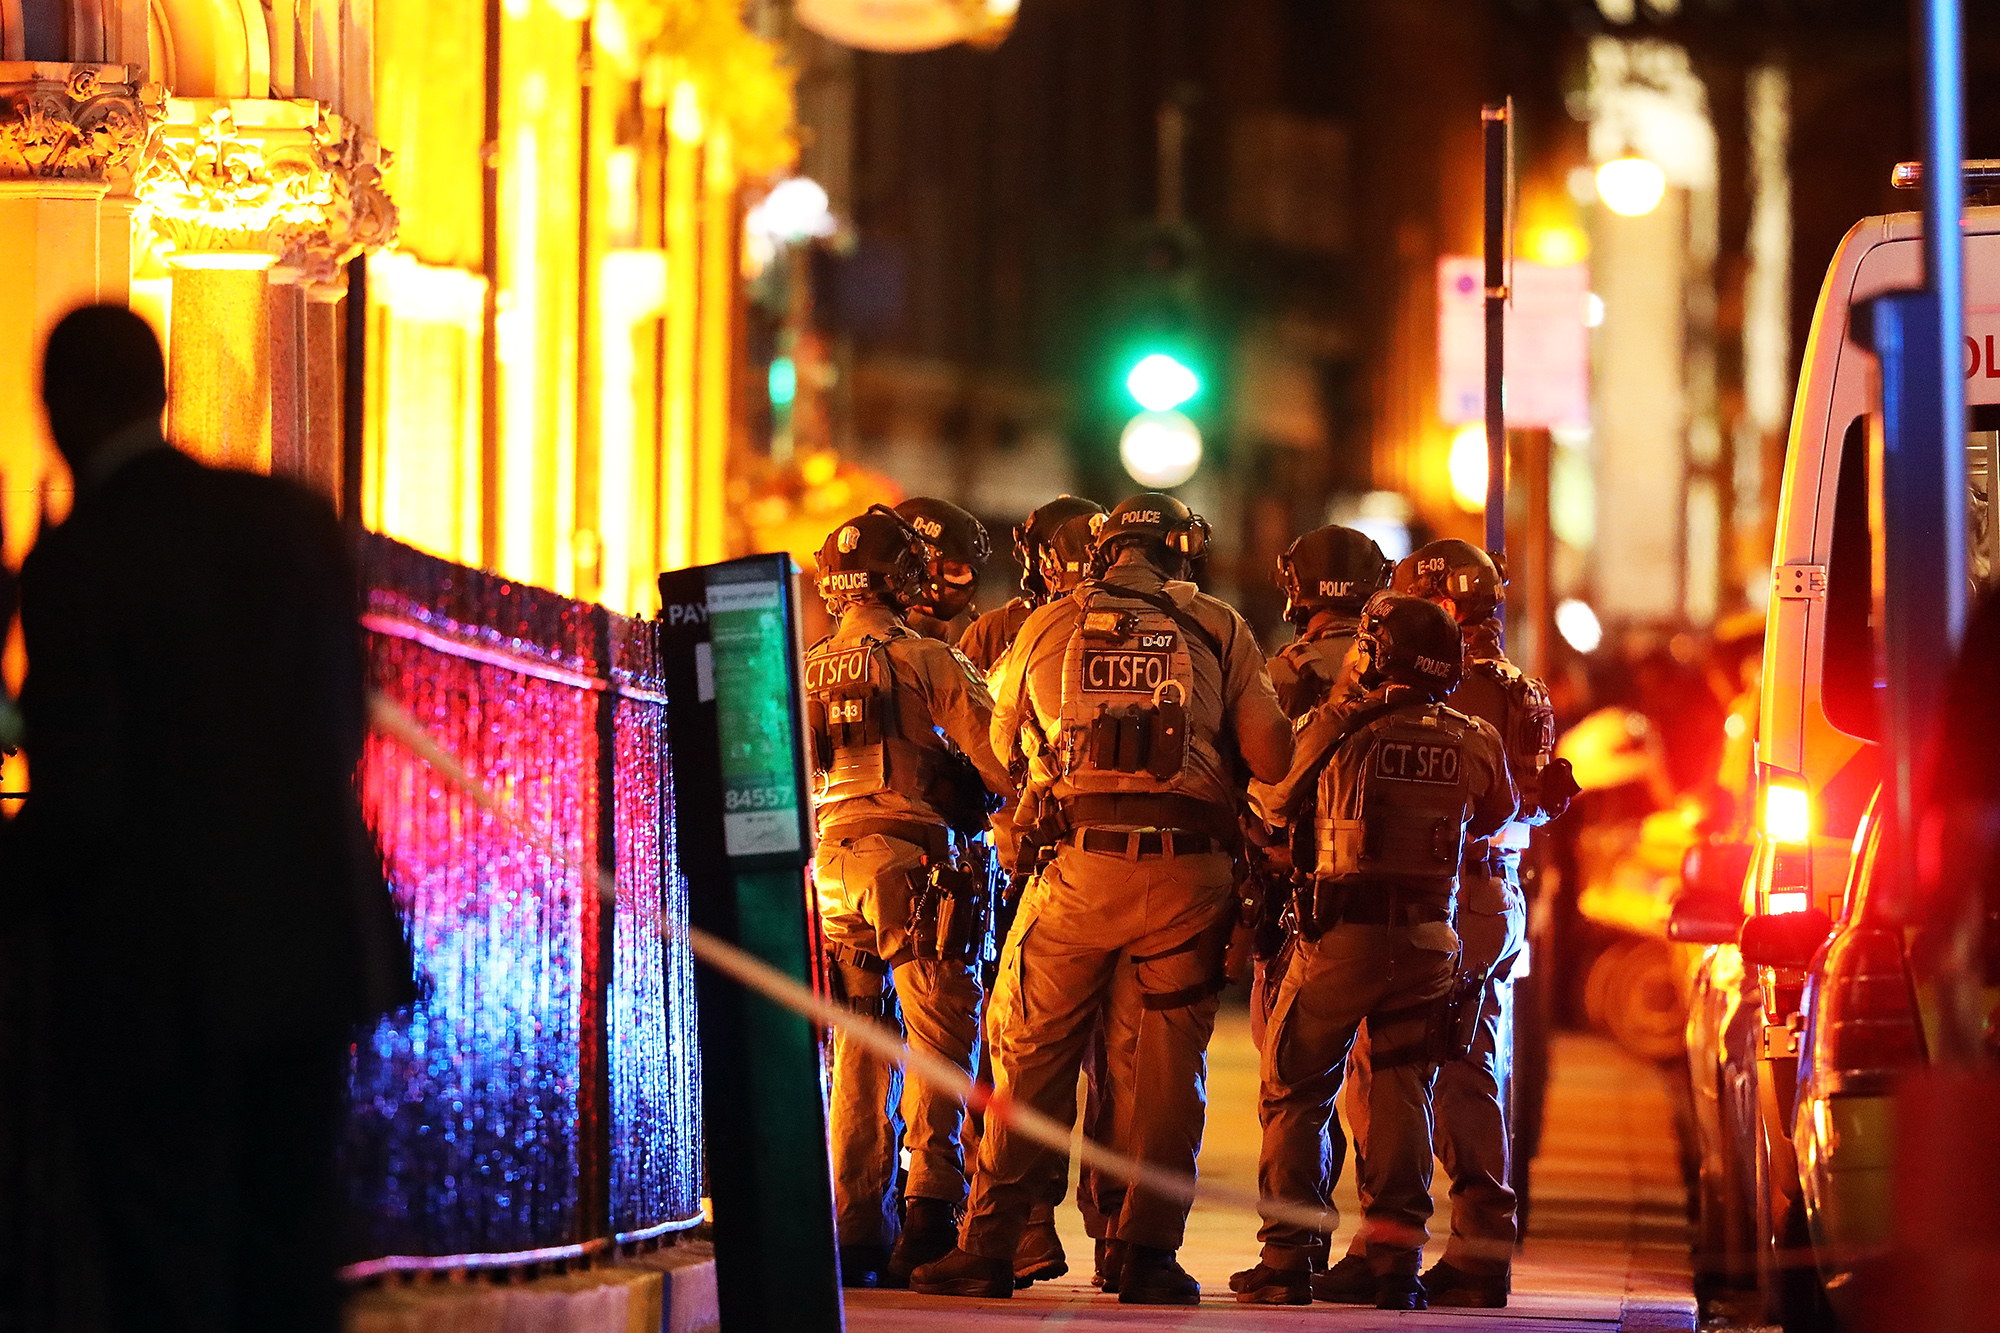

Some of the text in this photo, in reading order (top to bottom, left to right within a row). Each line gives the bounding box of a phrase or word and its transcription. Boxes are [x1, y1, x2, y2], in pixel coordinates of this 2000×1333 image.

[1121, 510, 1160, 525] POLICE
[1417, 557, 1445, 575] E-03
[831, 572, 868, 590] POLICE
[1319, 580, 1355, 597] POLIC
[668, 602, 710, 626] PAY
[1142, 633, 1173, 647] D-07
[805, 652, 863, 690] CTSFO
[1089, 655, 1162, 688] CTSFO
[1414, 655, 1450, 678] POLICE
[831, 704, 858, 719] D-03
[725, 785, 791, 809] 84557
